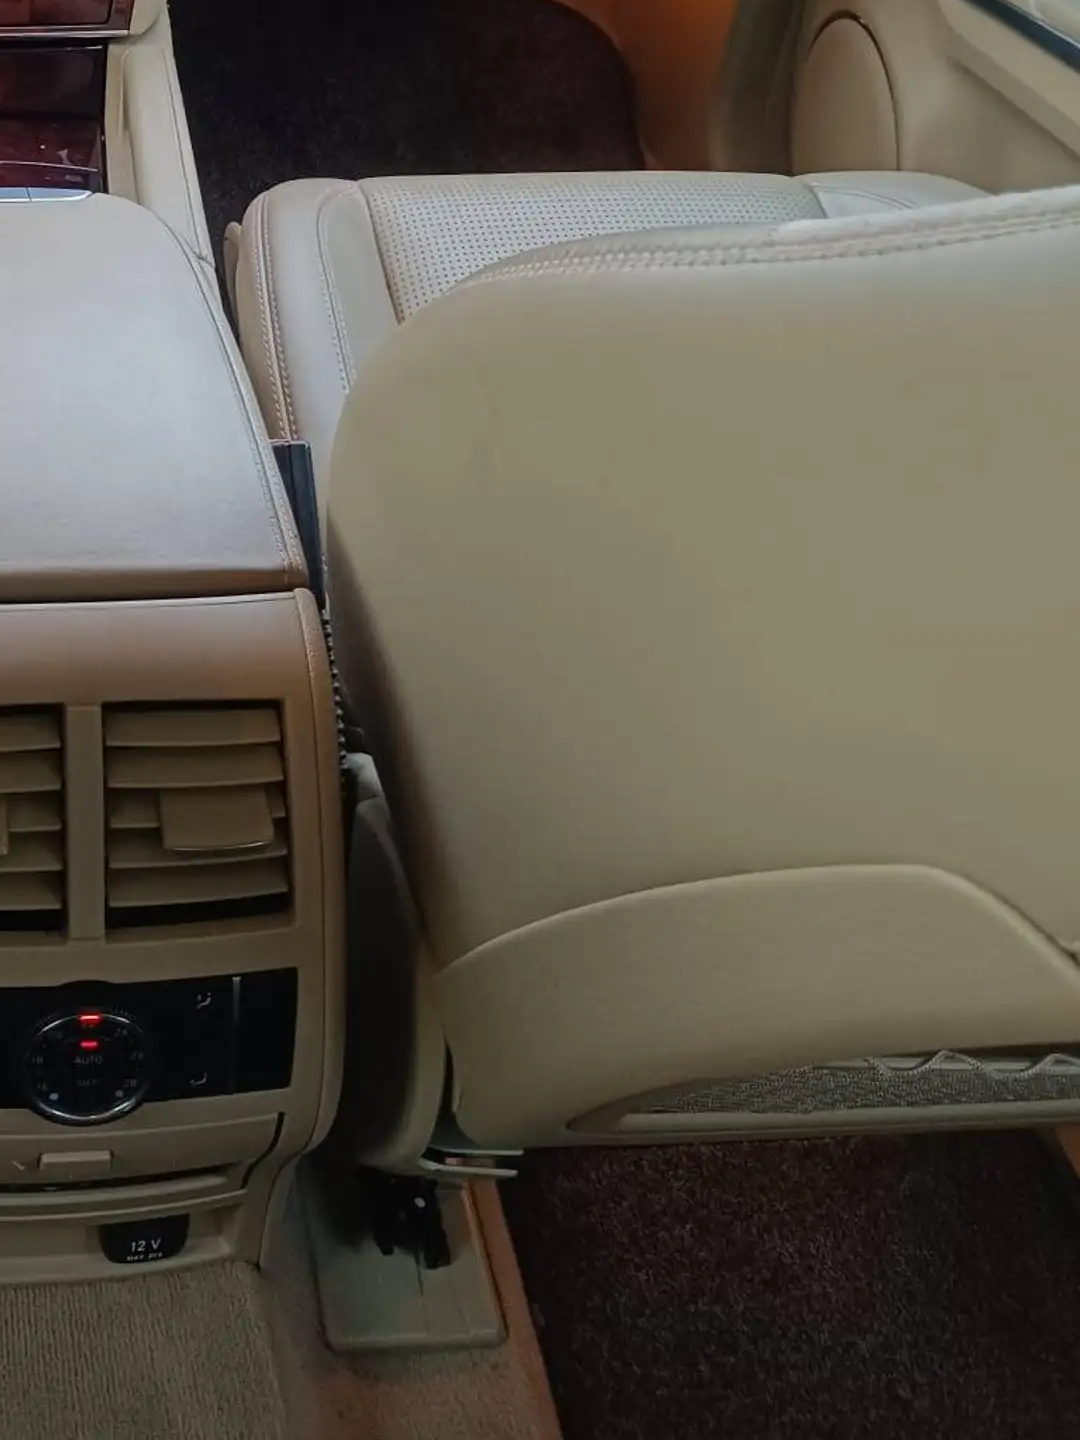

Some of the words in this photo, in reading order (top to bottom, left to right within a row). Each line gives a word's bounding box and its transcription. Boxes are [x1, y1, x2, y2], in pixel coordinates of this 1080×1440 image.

[74, 1055, 104, 1066] AUTO
[131, 1240, 146, 1253] 12
[151, 1238, 162, 1250] V
